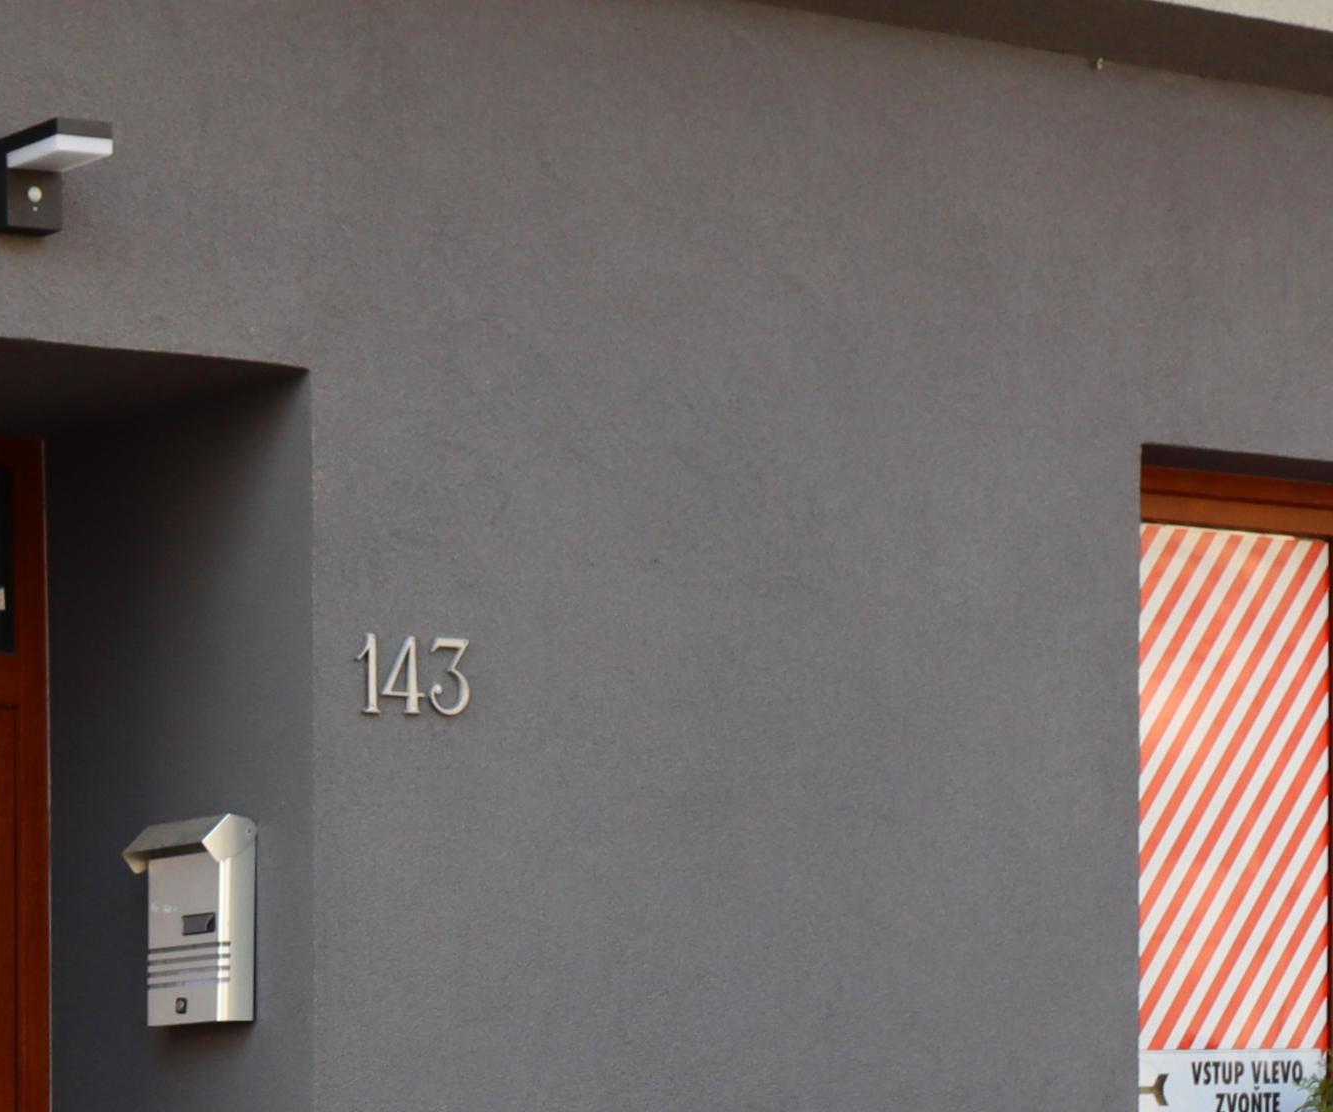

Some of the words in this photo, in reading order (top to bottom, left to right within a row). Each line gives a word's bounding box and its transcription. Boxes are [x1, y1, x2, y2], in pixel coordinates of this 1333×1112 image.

[356, 632, 471, 717] 143
[1191, 1061, 1244, 1085] VSTUP
[1251, 1060, 1303, 1085] VLEVO
